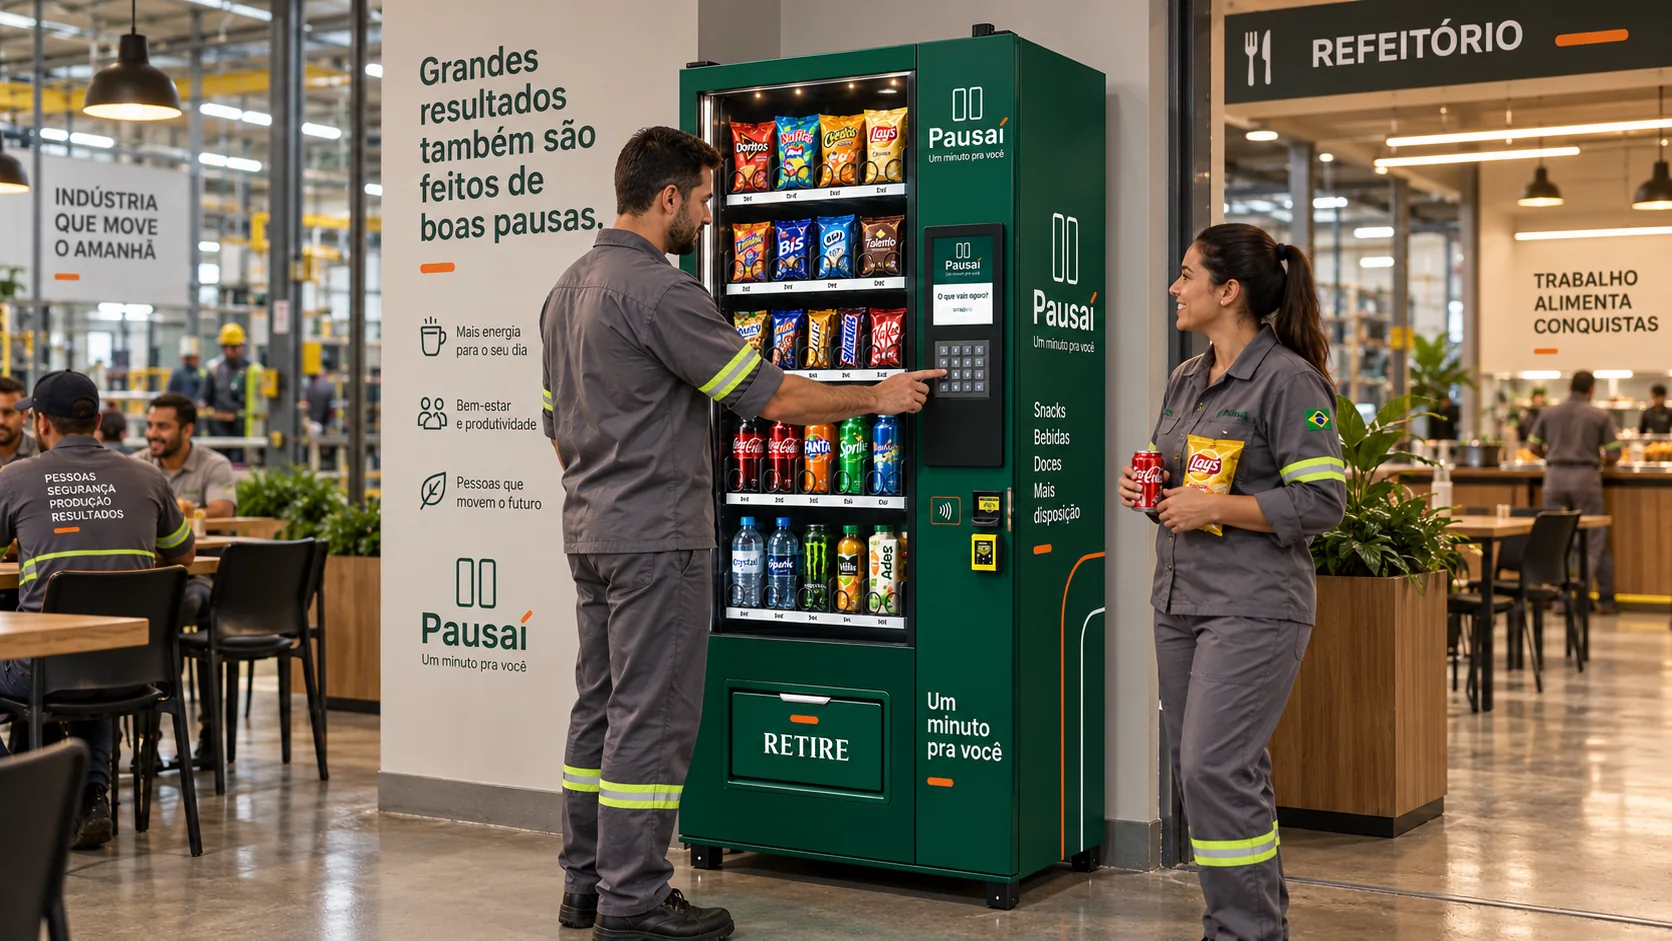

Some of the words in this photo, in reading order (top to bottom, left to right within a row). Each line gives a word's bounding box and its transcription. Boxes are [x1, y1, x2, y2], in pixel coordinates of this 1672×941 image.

[1312, 18, 1523, 68] REFEITÓRIO
[420, 45, 539, 86] Grandes
[420, 83, 567, 125] resultados
[420, 126, 534, 163] também
[543, 118, 596, 152] são
[929, 116, 1008, 149] Pausaí
[736, 142, 768, 153] Doritos
[928, 154, 942, 163] Um
[943, 152, 970, 162] minuto
[971, 152, 984, 161] pra
[420, 170, 499, 203] feitos
[508, 165, 544, 196] de
[56, 185, 158, 211] INDÚSTRIA
[55, 213, 97, 234] QUE
[104, 216, 158, 235] MOVE
[421, 213, 485, 241] boas
[494, 207, 604, 243] pausas.
[55, 239, 69, 257] O
[74, 239, 156, 260] AMANHÃ
[1534, 270, 1638, 288] TRABALHO
[1033, 288, 1097, 331] Pausaí
[1534, 294, 1632, 311] ALIMENTA
[456, 326, 480, 338] Mais
[482, 325, 521, 340] energia
[1534, 316, 1659, 334] CONQUISTAS
[456, 347, 479, 358] para
[481, 348, 488, 356] o
[490, 346, 509, 356] seu
[511, 344, 528, 356] dia
[1033, 335, 1045, 348] Um
[1045, 338, 1068, 351] minuto
[1069, 341, 1080, 353] pra
[456, 400, 511, 412] Bem-estar
[1034, 401, 1066, 419] Snacks
[456, 421, 463, 430] e
[465, 418, 537, 432] produtividade
[1034, 428, 1070, 445] Bebidas
[1034, 455, 1062, 472] Doces
[45, 472, 97, 483] PESSOAS
[456, 476, 501, 490] Pessoas
[503, 479, 524, 492] que
[47, 484, 117, 495] SEGURANÇA
[1034, 482, 1055, 499] Mais
[49, 496, 112, 509] PRODUÇÃO
[456, 498, 496, 509] movem
[498, 499, 506, 509] o
[508, 496, 542, 510] futuro
[51, 509, 124, 522] RESULTADOS
[1034, 504, 1081, 526] disposição
[422, 609, 533, 651] Pausaí
[421, 653, 439, 666] Um
[442, 655, 478, 669] minuto
[480, 660, 498, 672] pra
[501, 660, 527, 672] você
[927, 692, 957, 711] Um
[927, 714, 990, 737] minuto
[763, 732, 850, 762] RETIRE
[927, 741, 956, 760] pra
[960, 741, 1003, 762] você
